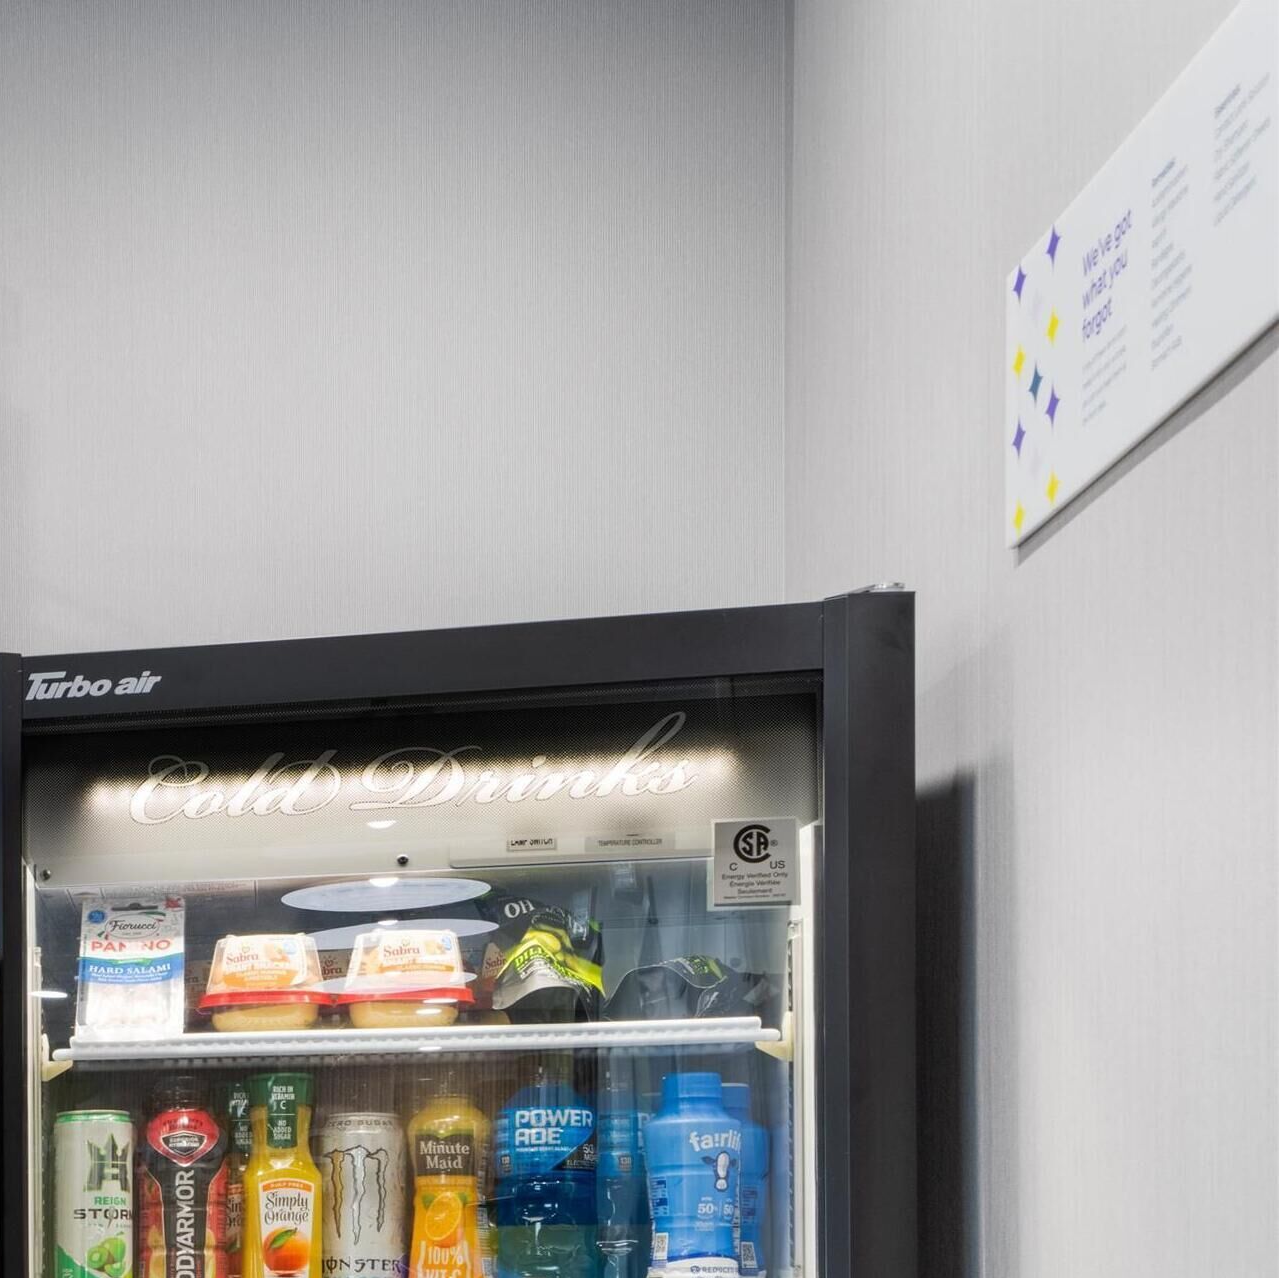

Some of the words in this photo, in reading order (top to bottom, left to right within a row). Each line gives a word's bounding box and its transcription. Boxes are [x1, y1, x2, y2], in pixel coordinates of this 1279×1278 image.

[1114, 210, 1131, 249] got
[1083, 270, 1106, 310] what
[1110, 248, 1127, 289] you
[1082, 297, 1111, 342] forgot
[25, 671, 113, 700] Turbo
[115, 670, 162, 695] air
[130, 749, 342, 825] Cold
[349, 711, 699, 811] Drinks
[109, 919, 157, 932] Fiorucci
[225, 950, 259, 964] Sabra
[89, 965, 124, 975] HARD
[128, 964, 171, 974] SALAMI
[419, 1141, 470, 1155] Minute
[426, 1155, 463, 1170] Maid
